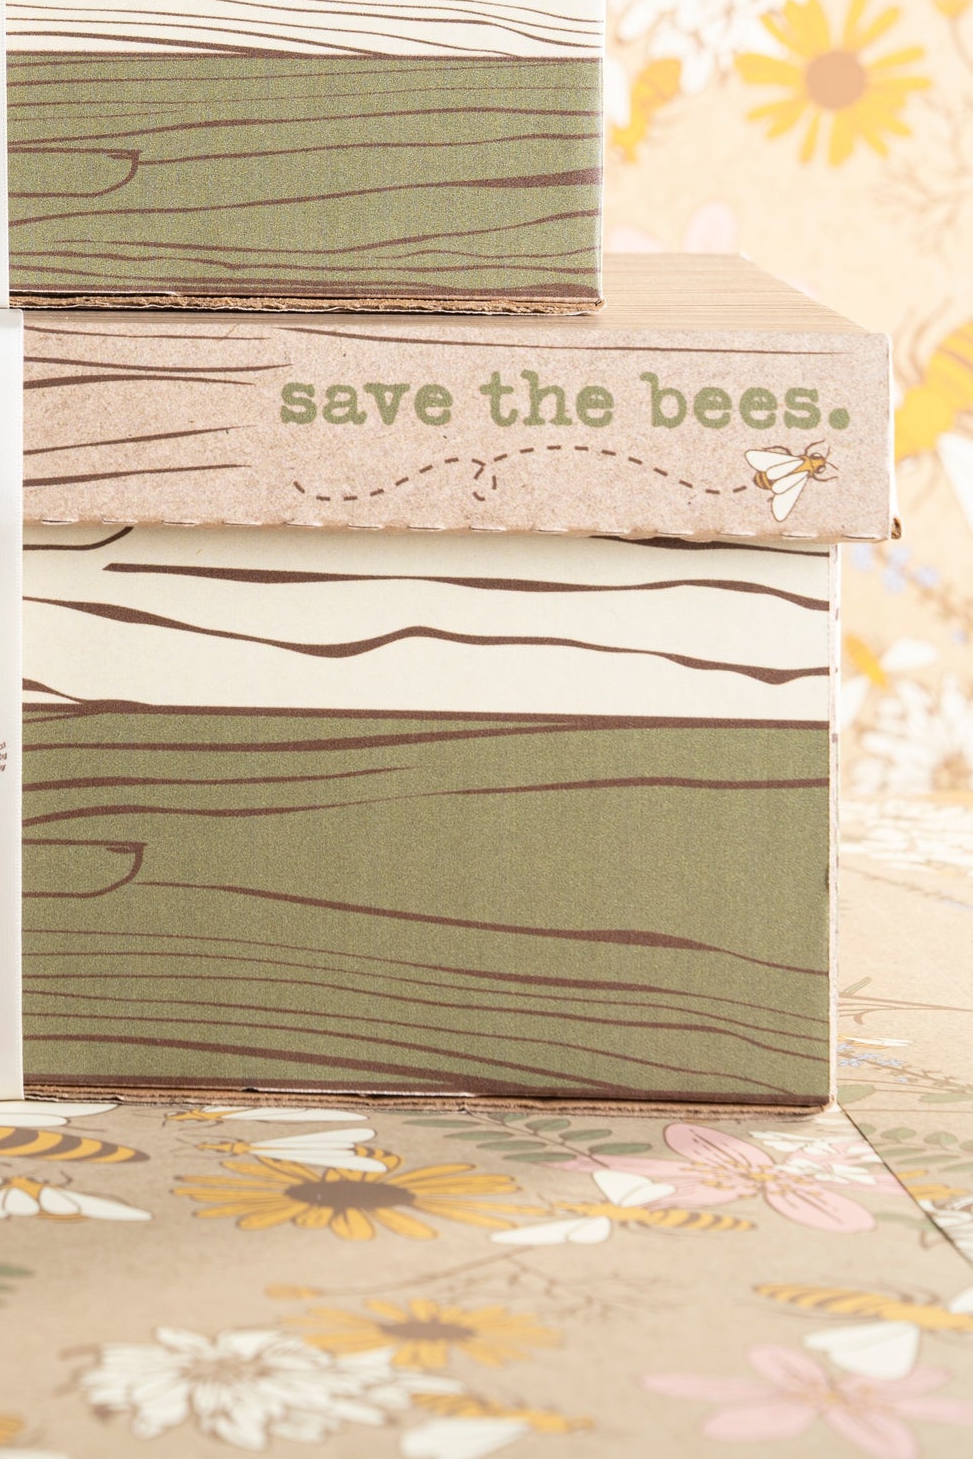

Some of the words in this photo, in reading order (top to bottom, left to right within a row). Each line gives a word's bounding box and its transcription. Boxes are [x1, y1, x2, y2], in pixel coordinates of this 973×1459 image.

[279, 381, 454, 427] save
[480, 369, 614, 428] the
[640, 372, 851, 430] bees.
